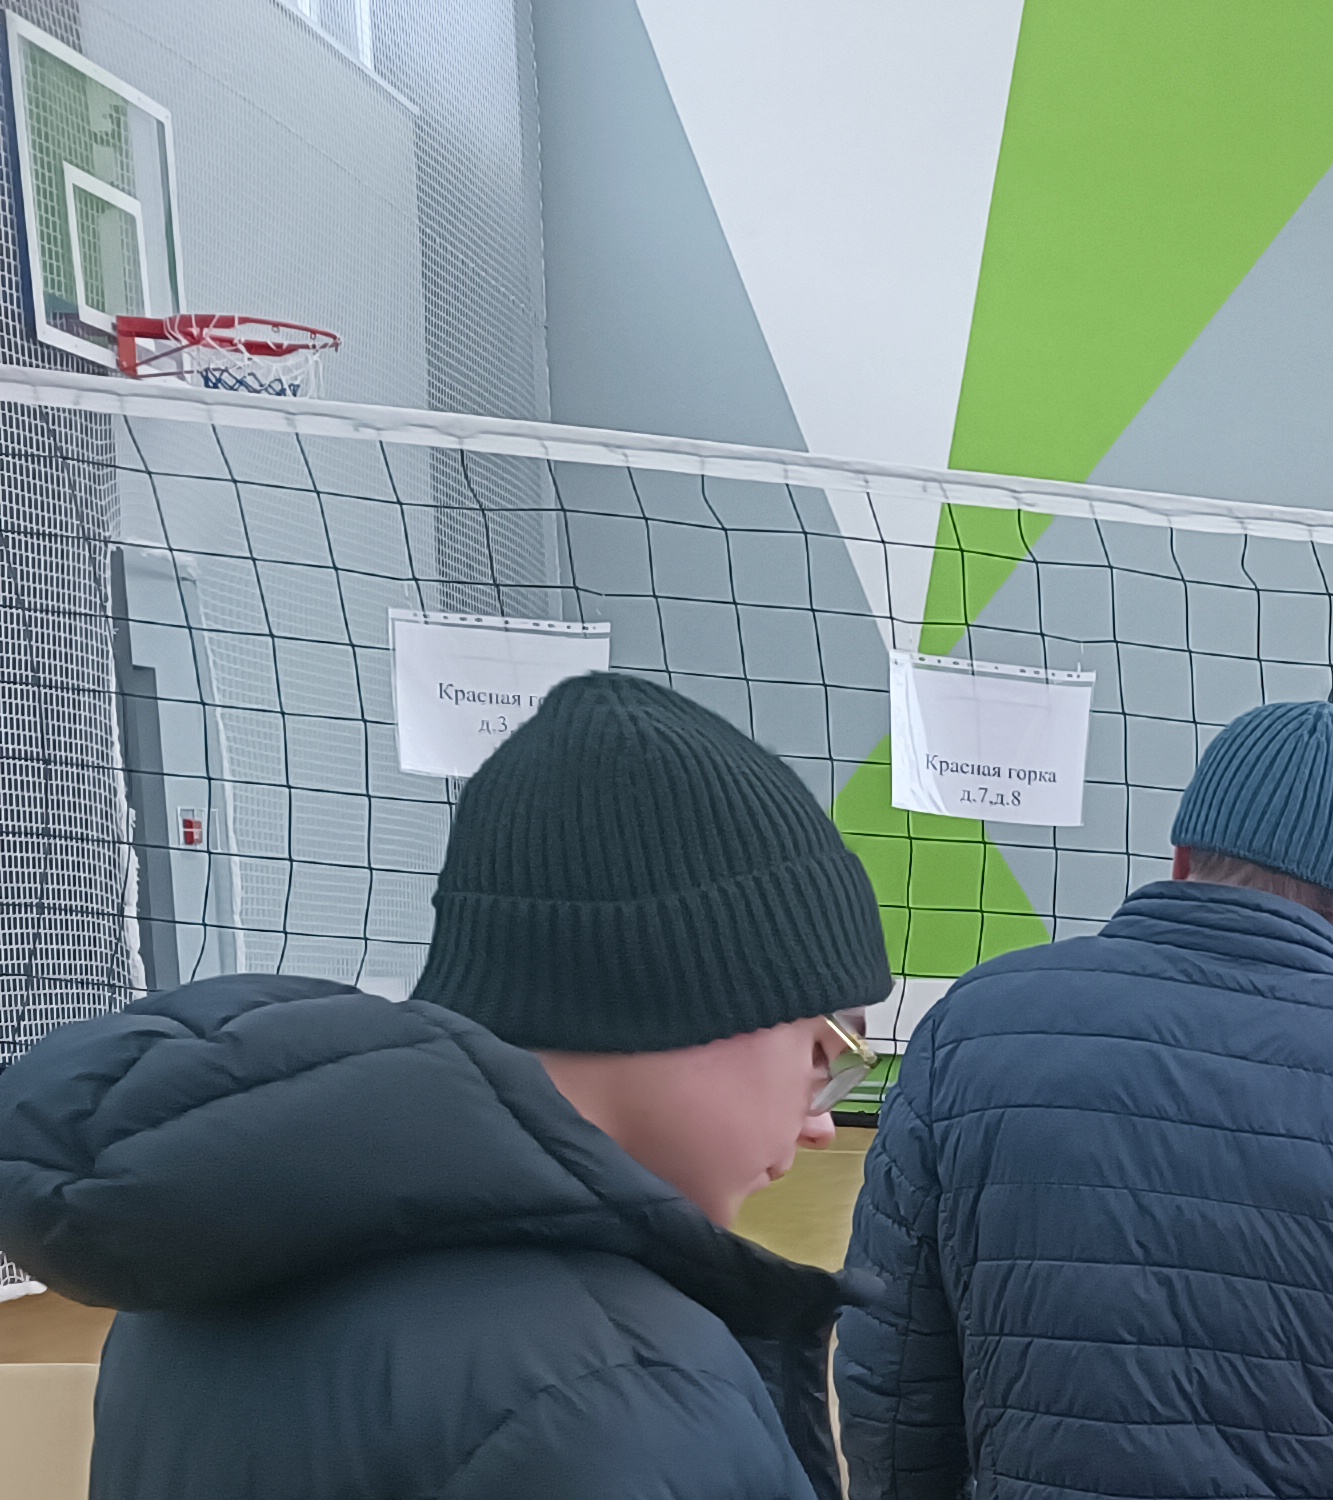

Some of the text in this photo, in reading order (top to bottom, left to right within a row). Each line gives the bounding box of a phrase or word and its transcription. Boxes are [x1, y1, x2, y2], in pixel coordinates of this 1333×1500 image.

[437, 682, 521, 706] Красная
[925, 753, 1057, 786] Красная горка
